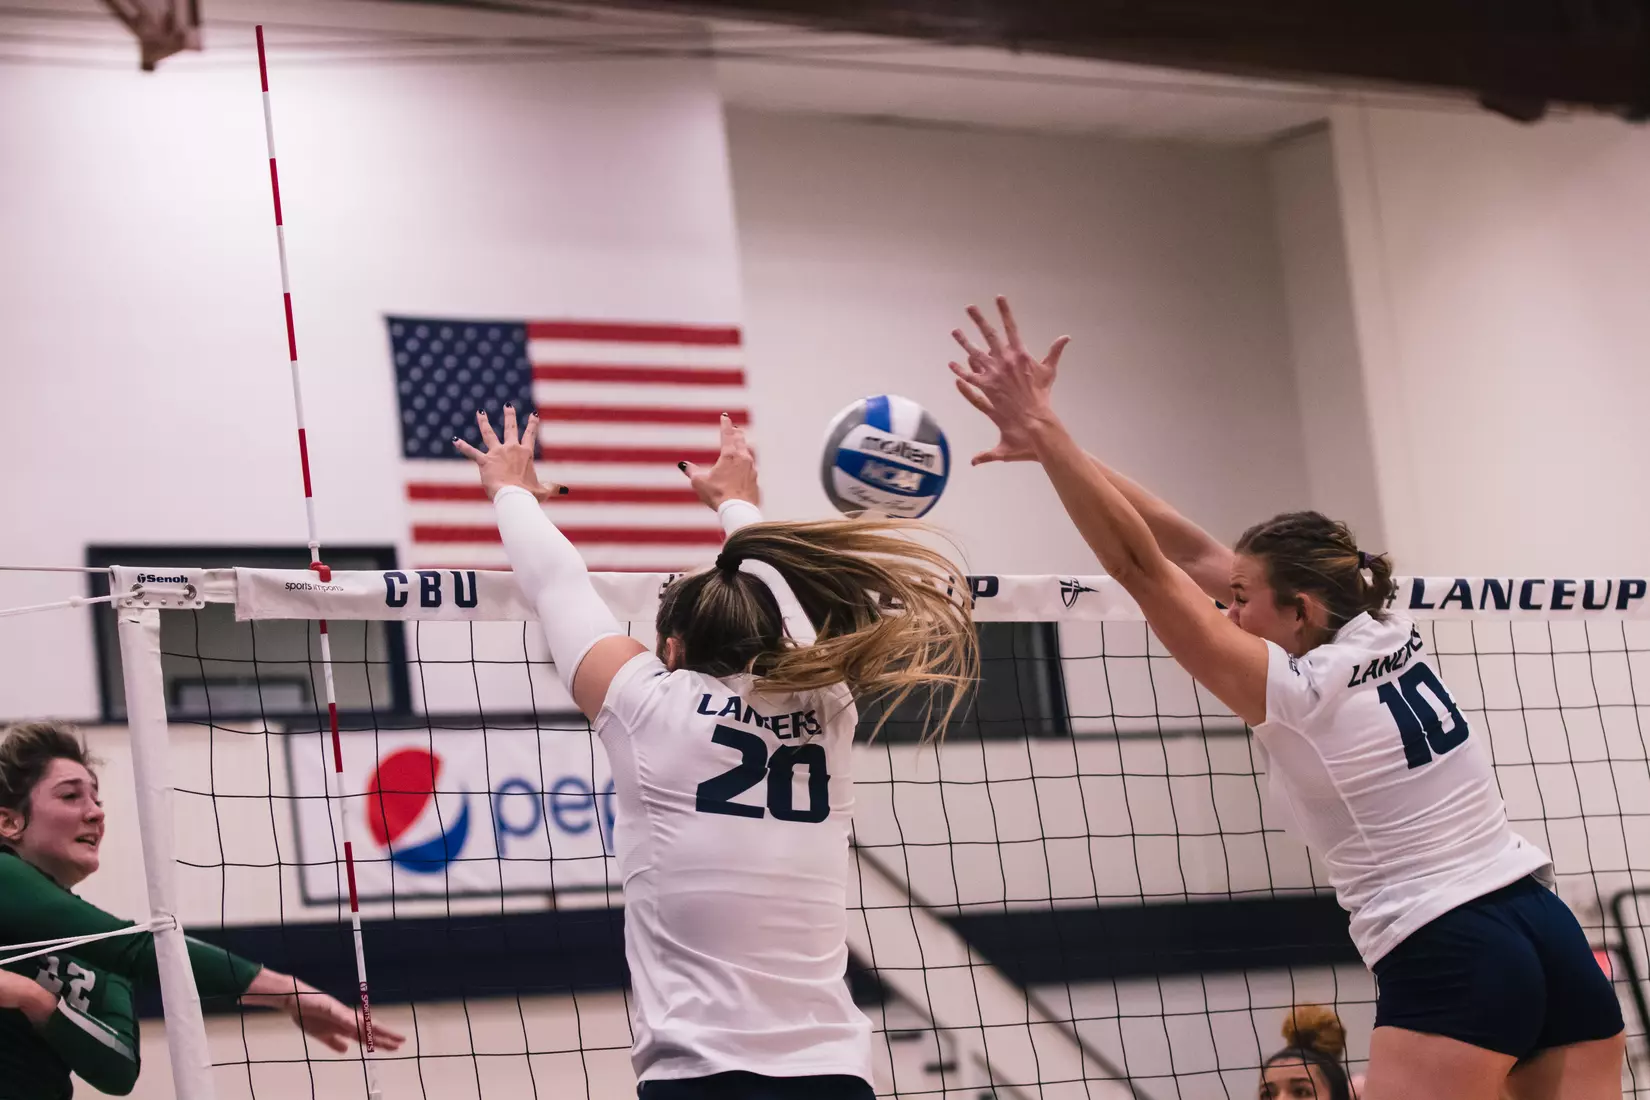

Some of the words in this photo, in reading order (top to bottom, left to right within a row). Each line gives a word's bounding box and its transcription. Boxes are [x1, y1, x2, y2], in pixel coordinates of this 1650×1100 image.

[146, 574, 188, 584] Senoh
[284, 582, 312, 592] sports
[383, 570, 478, 609] CBU
[696, 693, 823, 740] LANERS
[1376, 661, 1470, 770] 10
[695, 723, 831, 824] 20
